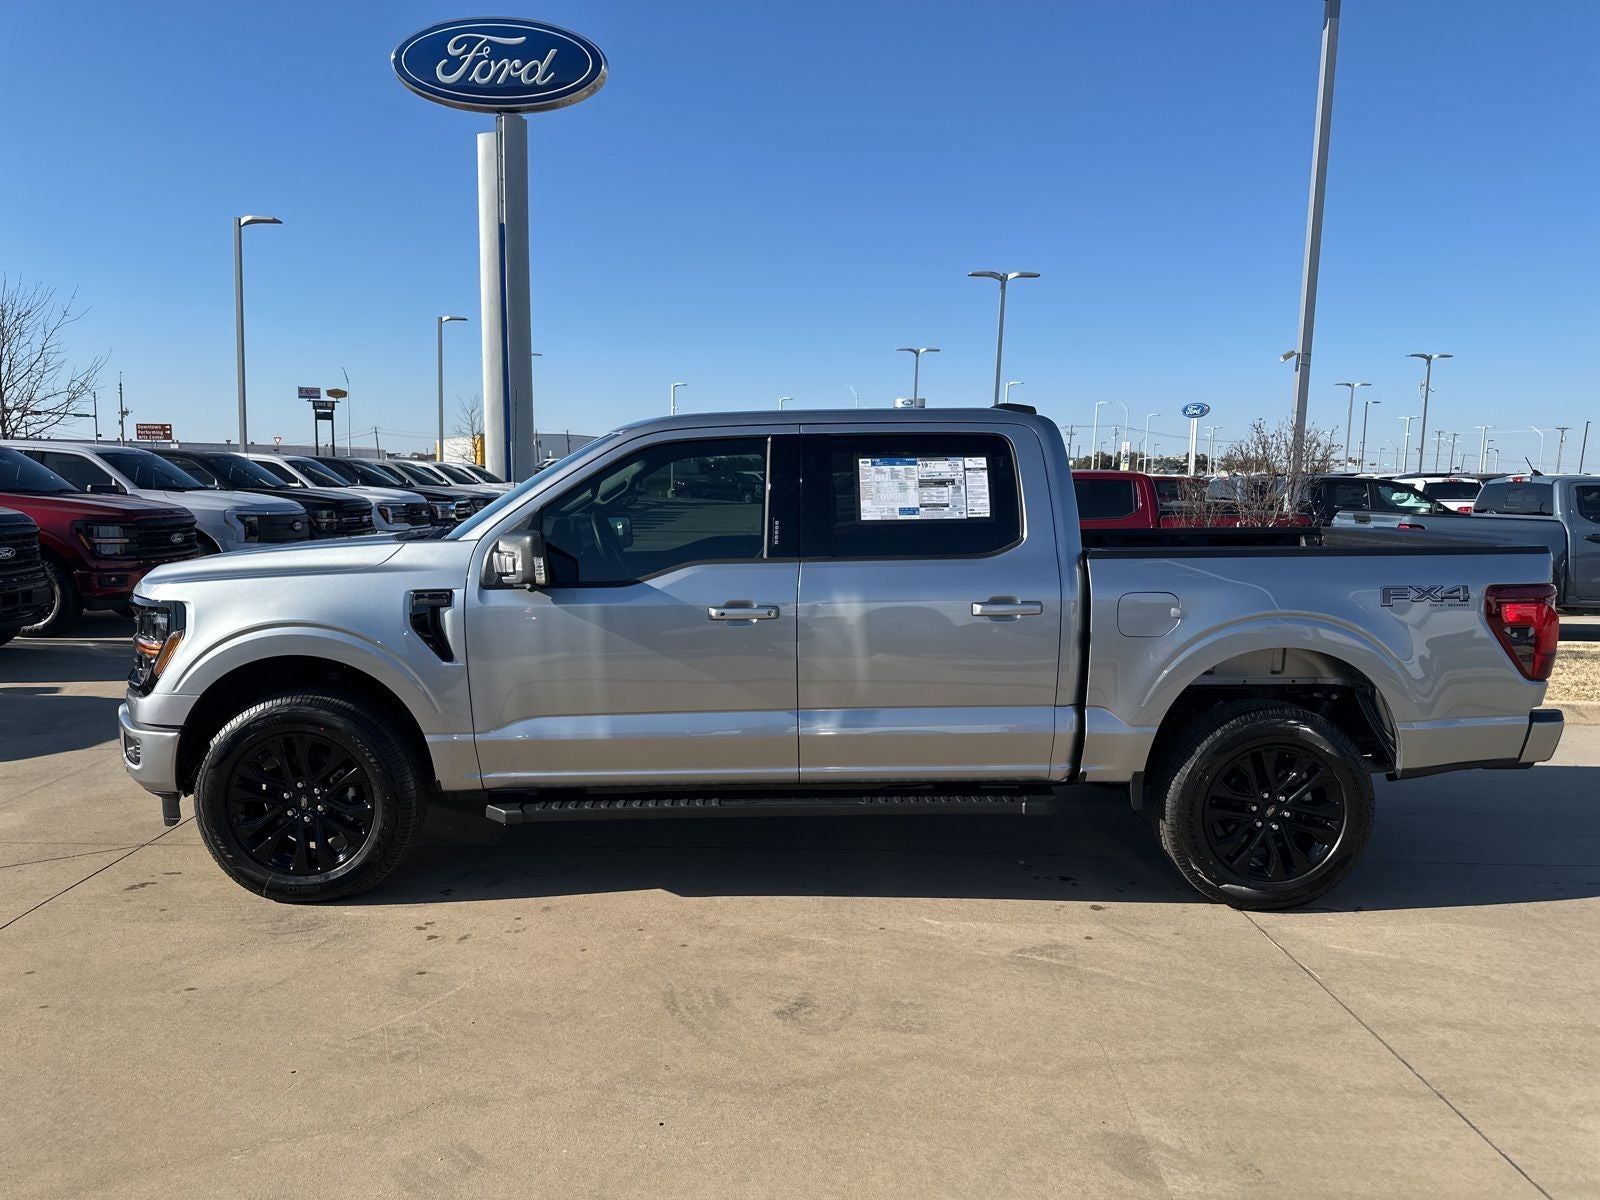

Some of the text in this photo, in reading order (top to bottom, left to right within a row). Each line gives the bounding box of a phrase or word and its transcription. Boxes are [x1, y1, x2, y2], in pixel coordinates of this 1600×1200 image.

[435, 33, 559, 86] Ford
[1185, 405, 1202, 415] Ford
[1380, 585, 1470, 607] FX4
